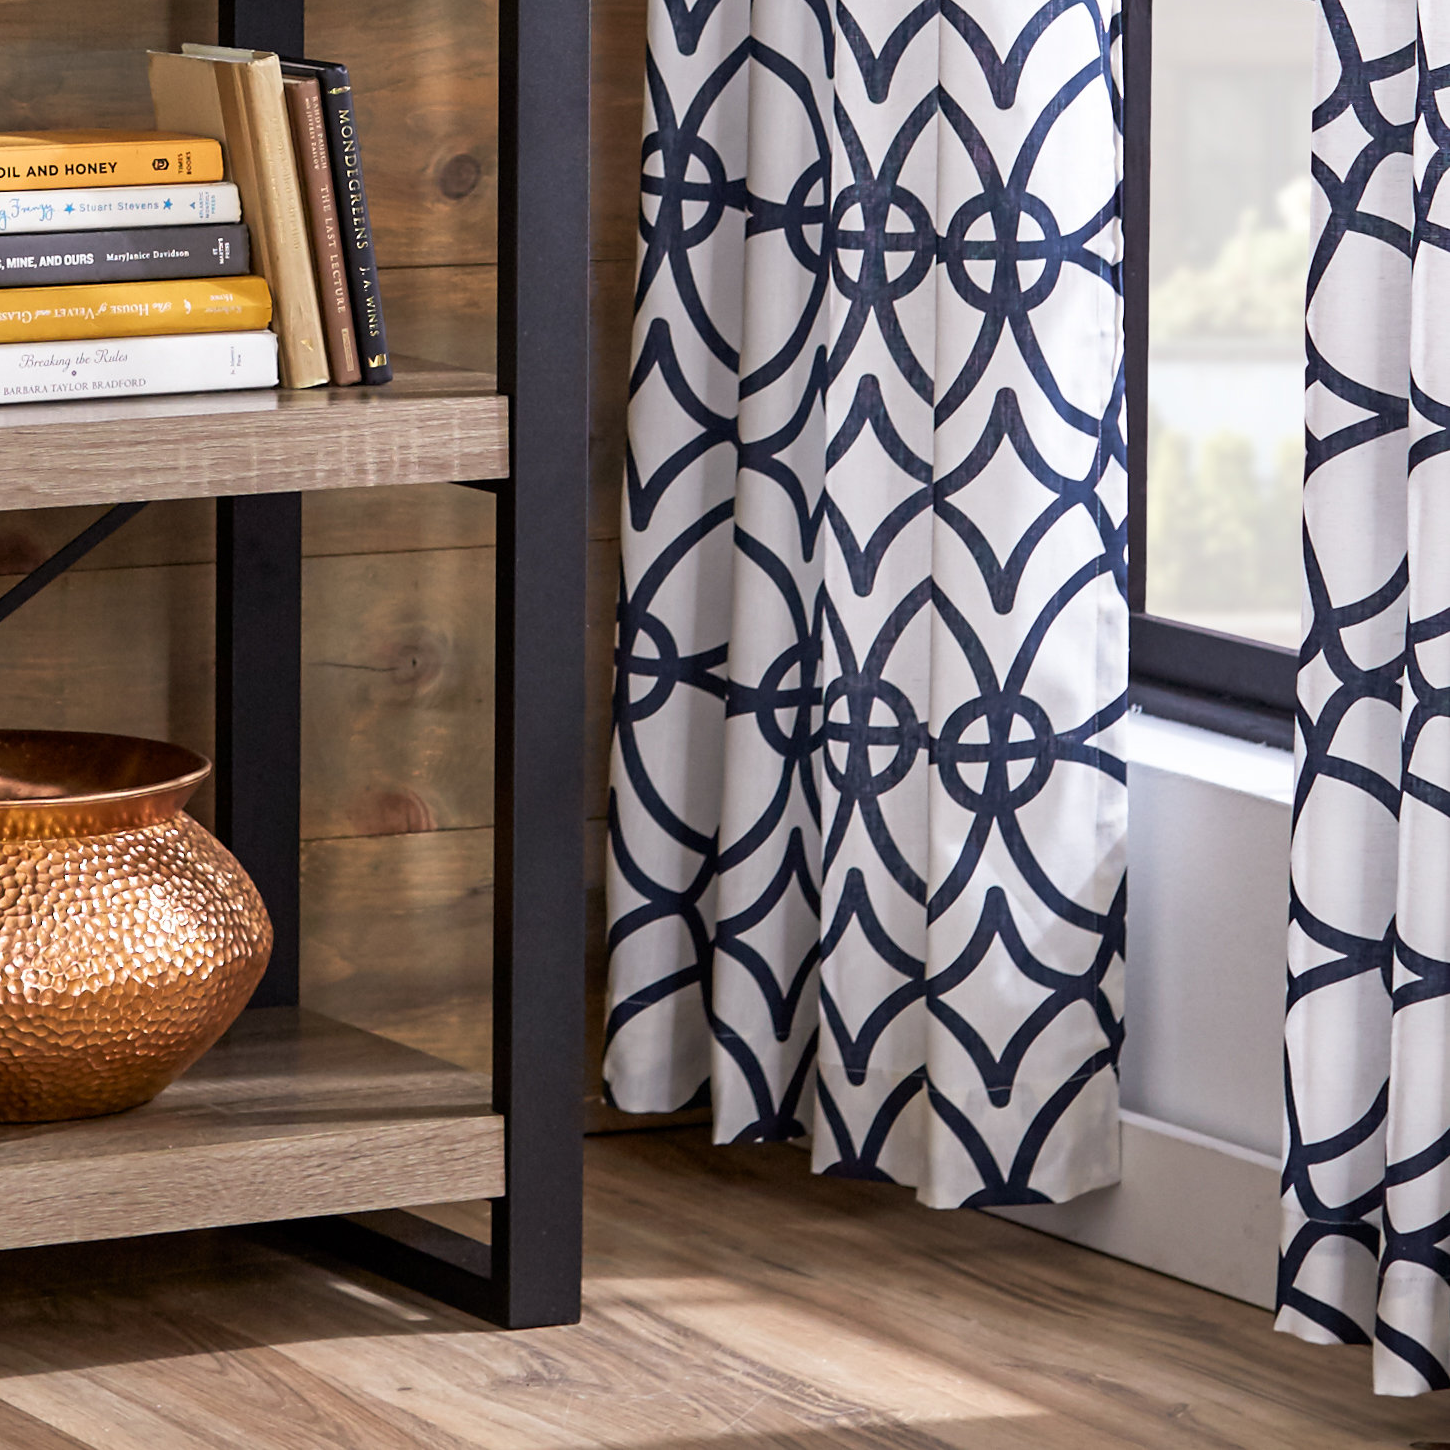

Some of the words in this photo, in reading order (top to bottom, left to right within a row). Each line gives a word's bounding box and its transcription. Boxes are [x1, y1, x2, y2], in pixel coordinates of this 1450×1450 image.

[26, 165, 59, 177] AND
[65, 162, 118, 176] HONEY
[338, 110, 369, 249] MONDEGREENS
[320, 184, 332, 212] THE
[79, 203, 112, 212] Stuart
[117, 201, 159, 211] Stevens
[325, 217, 337, 248] LAST
[6, 256, 38, 269] MINE,
[39, 255, 63, 267] AND
[64, 253, 95, 265] OURS
[106, 251, 151, 262] MaryJanice
[153, 249, 190, 259] Davidson
[359, 267, 370, 276] J.
[330, 254, 346, 313] LECTURE
[363, 280, 372, 291] A.
[95, 302, 108, 316] of
[152, 301, 173, 313] The
[366, 295, 380, 336] WINES
[18, 354, 71, 372] Breaking
[75, 351, 91, 364] the
[93, 349, 128, 364] Rules
[3, 383, 48, 396] BARBARA
[51, 381, 89, 394] TAYLOR
[92, 378, 147, 391] BRADFORD
